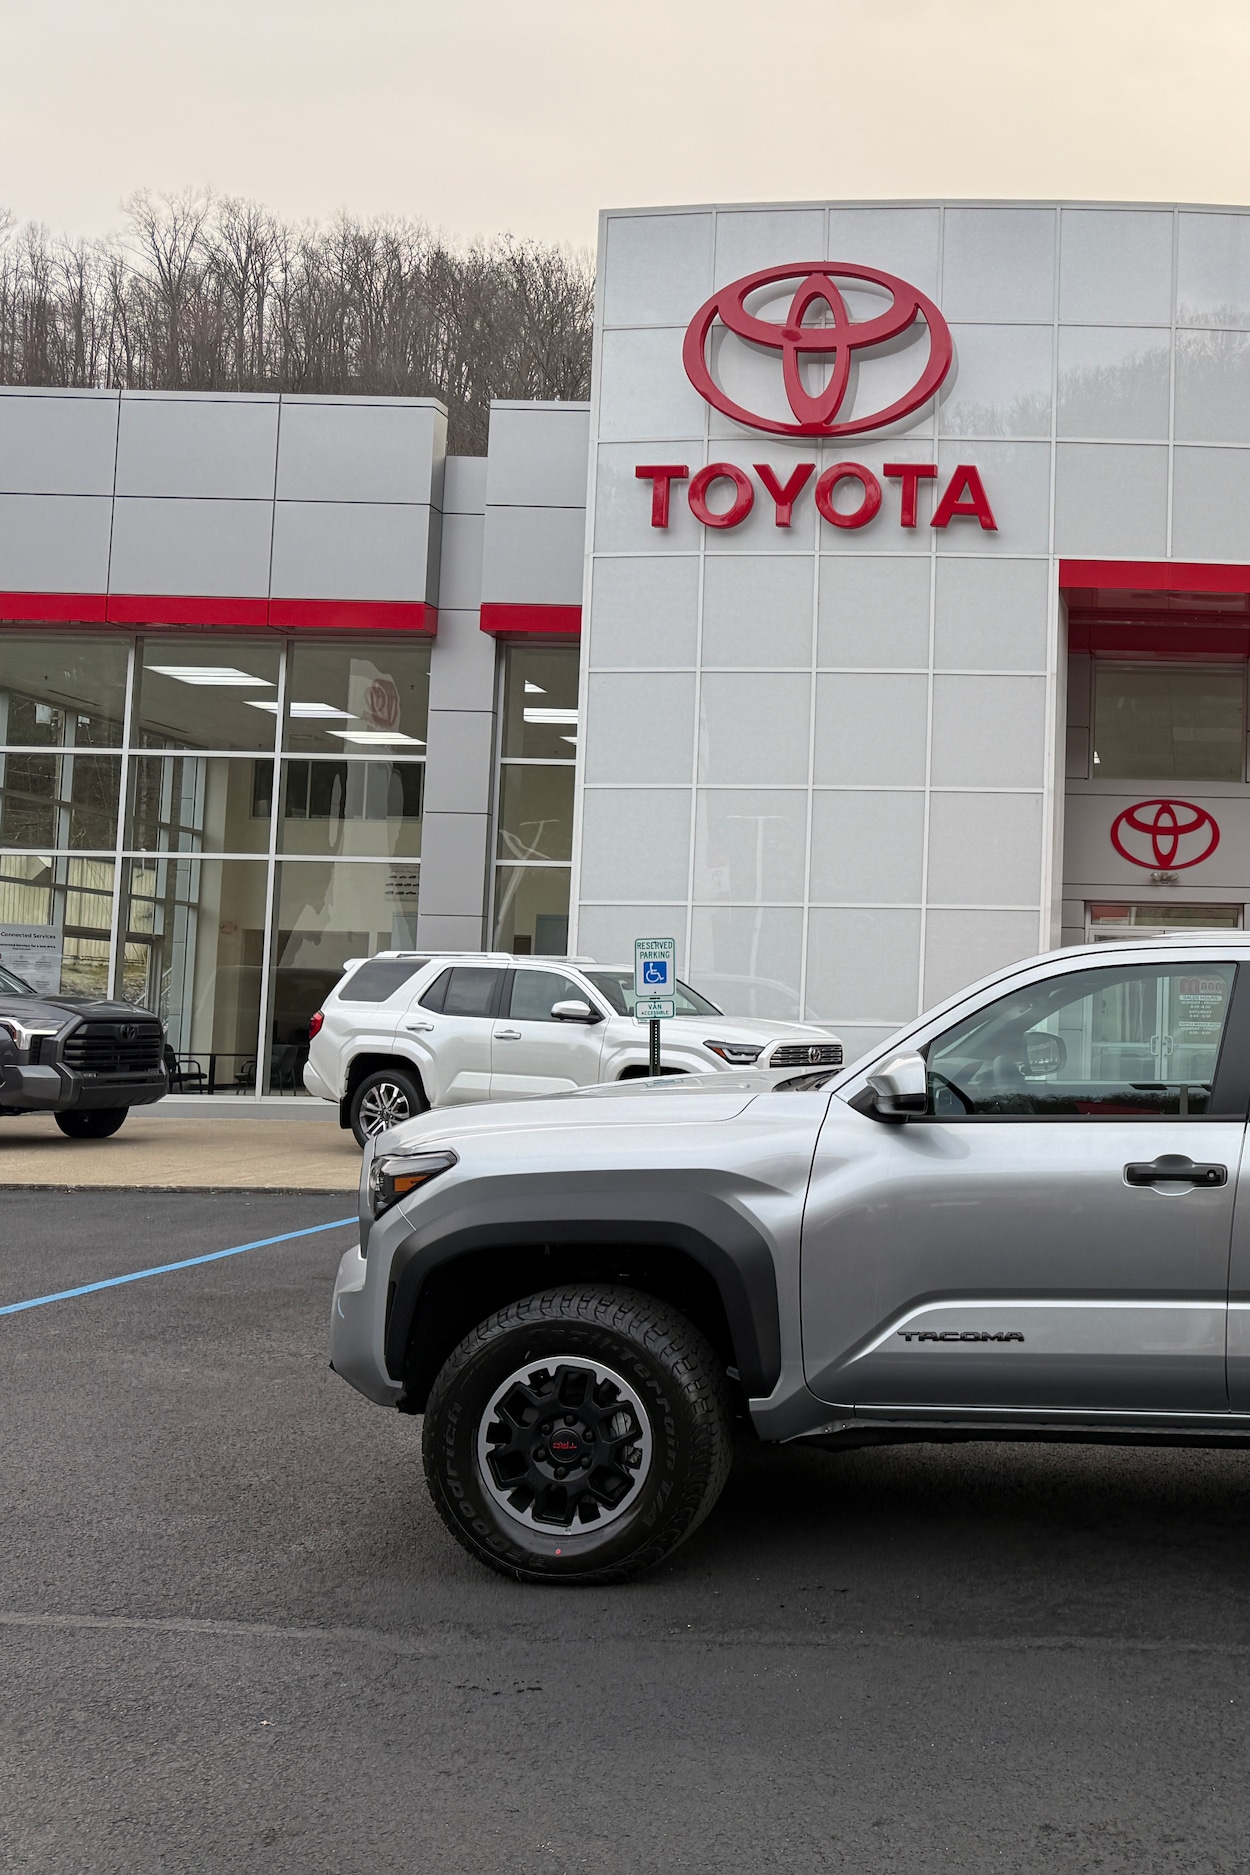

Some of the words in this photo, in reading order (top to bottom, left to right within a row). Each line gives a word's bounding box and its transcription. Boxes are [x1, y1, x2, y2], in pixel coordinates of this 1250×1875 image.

[635, 462, 998, 531] TOYOTA
[637, 941, 672, 950] RESERVED
[640, 951, 670, 959] PARKING
[897, 1331, 1025, 1342] TACOMA
